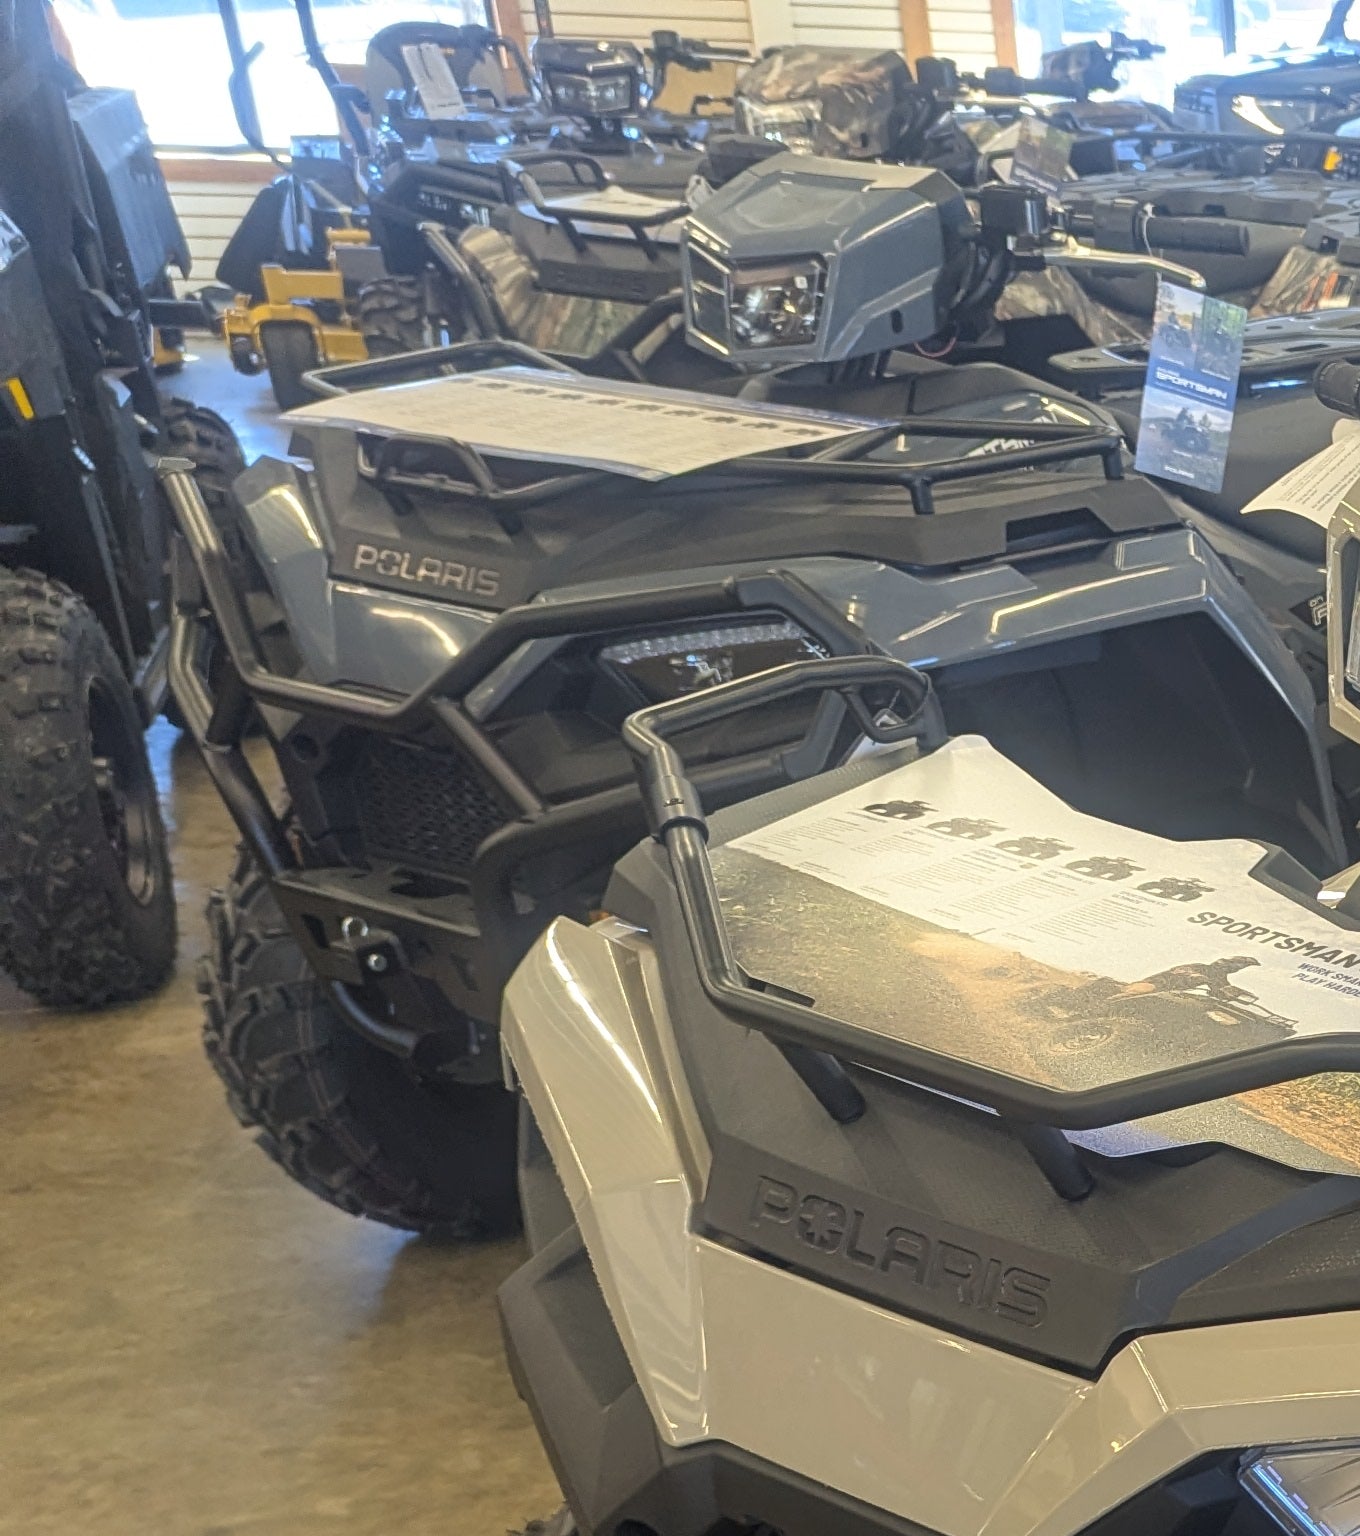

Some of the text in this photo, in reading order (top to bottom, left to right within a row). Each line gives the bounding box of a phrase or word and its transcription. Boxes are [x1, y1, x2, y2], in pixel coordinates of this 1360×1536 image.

[1155, 369, 1228, 400] SPORTSMAN
[354, 543, 500, 597] POLARIS
[1292, 973, 1328, 987] PLAY
[1298, 962, 1332, 979] WORK
[753, 1174, 1052, 1329] POLARIS
